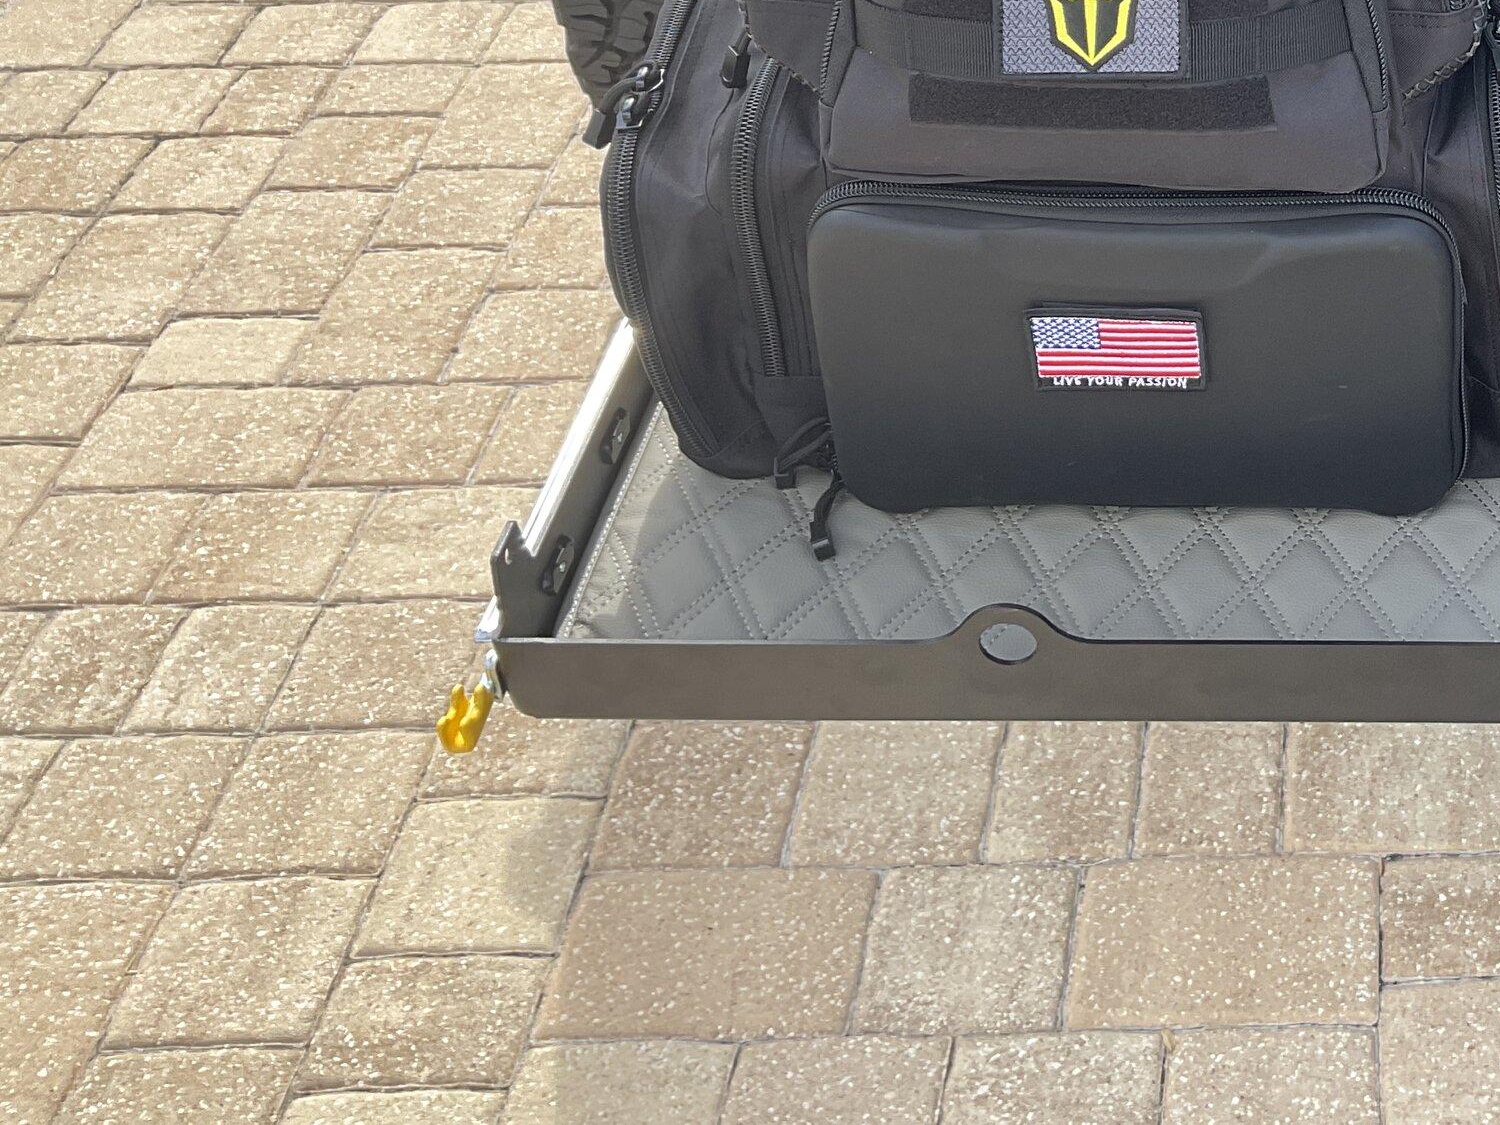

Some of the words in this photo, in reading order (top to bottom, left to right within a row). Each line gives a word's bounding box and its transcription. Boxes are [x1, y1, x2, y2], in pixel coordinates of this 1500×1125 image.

[1053, 377, 1082, 387] LIVE
[1087, 377, 1124, 387] YOUR
[1128, 377, 1188, 389] PASSION
